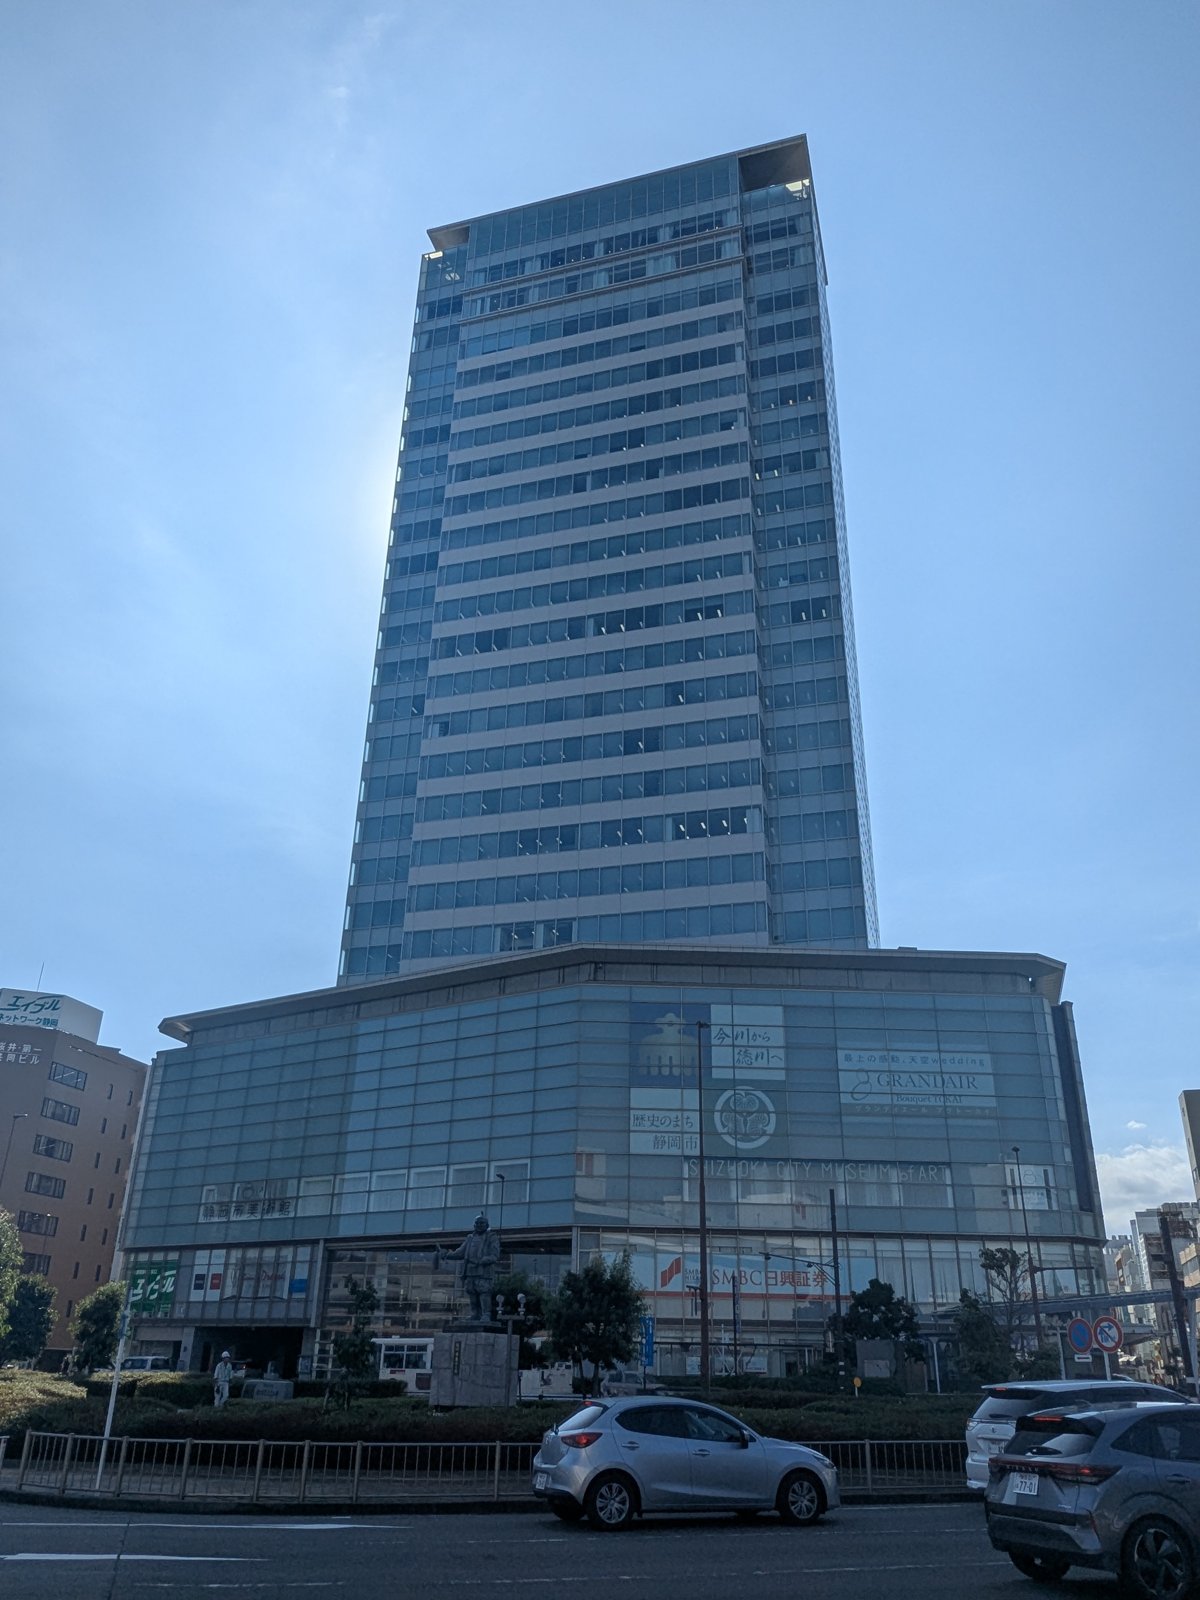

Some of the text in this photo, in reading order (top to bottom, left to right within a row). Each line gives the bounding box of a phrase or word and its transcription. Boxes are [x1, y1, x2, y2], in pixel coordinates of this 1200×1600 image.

[1, 995, 65, 1014] エイブル
[713, 1027, 771, 1045] 今川から
[736, 1048, 784, 1066] 徳川へ
[876, 1073, 979, 1091] GRANDAIR
[632, 1113, 695, 1129] 歴史のまち
[653, 1134, 699, 1151] 静岡市
[777, 1161, 813, 1179] CITY
[821, 1162, 891, 1181] MUSEUM
[918, 1164, 946, 1183] ART
[712, 1268, 829, 1288] SMBC日興証券
